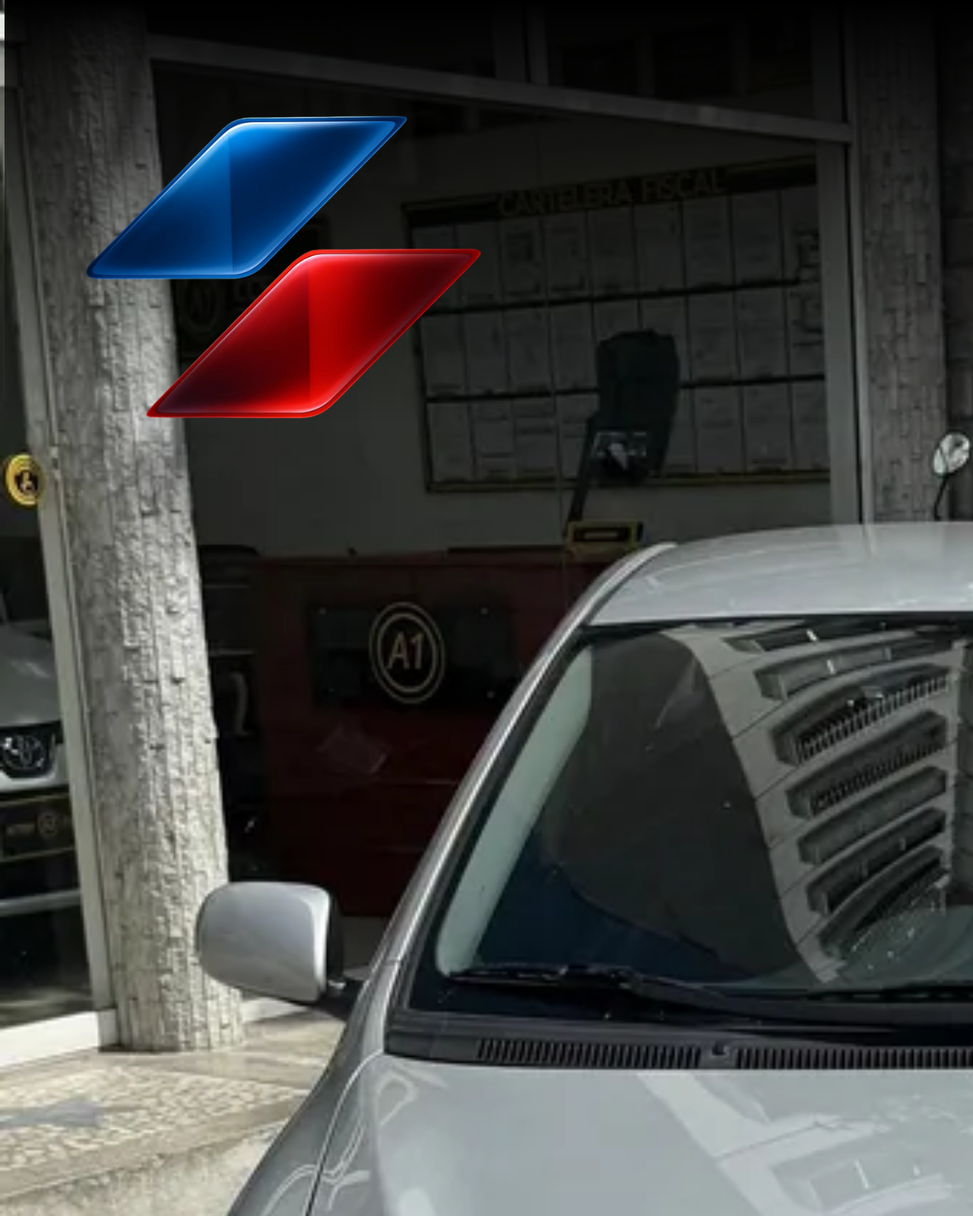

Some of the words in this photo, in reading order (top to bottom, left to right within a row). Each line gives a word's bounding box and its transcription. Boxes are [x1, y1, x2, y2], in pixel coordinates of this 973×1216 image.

[498, 177, 633, 217] CARTELERA
[641, 168, 728, 203] FISCAL
[386, 630, 424, 670] A1
